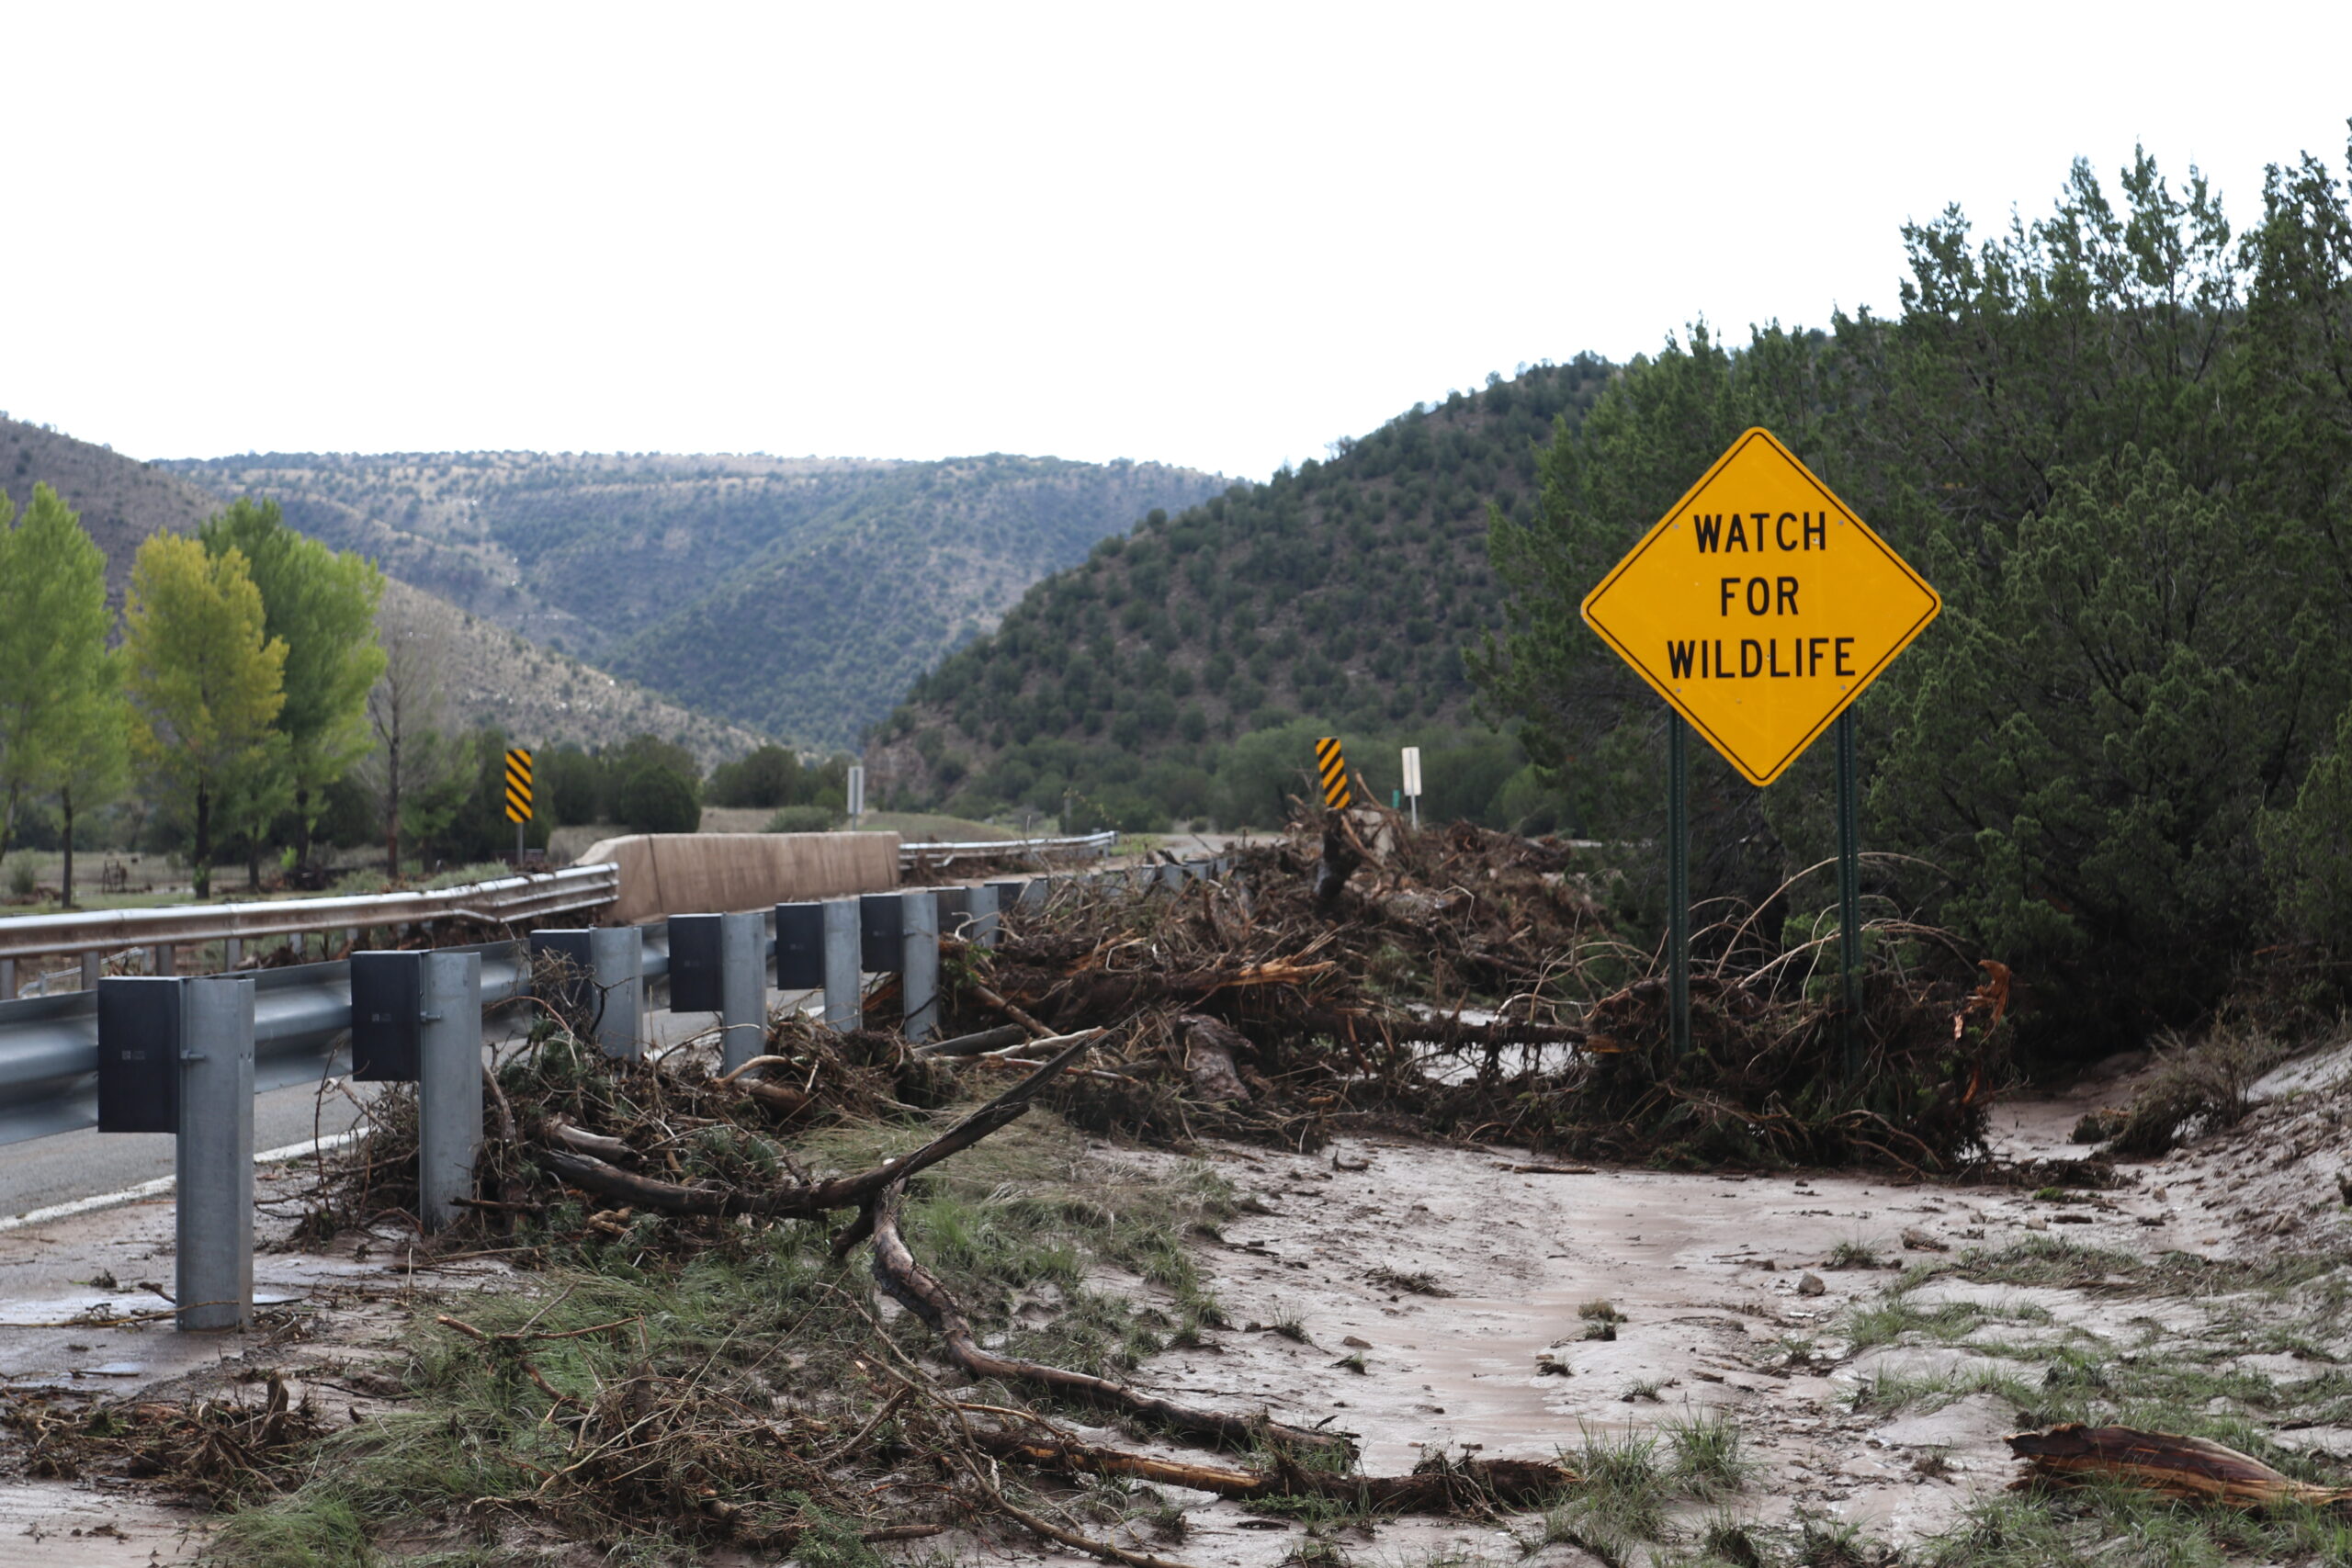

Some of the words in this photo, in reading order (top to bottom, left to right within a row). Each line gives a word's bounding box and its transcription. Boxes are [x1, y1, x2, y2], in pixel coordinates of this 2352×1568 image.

[1693, 511, 1826, 554] WATCH
[1720, 576, 1800, 617] FOR
[1667, 637, 1857, 680] WILDLIFE
